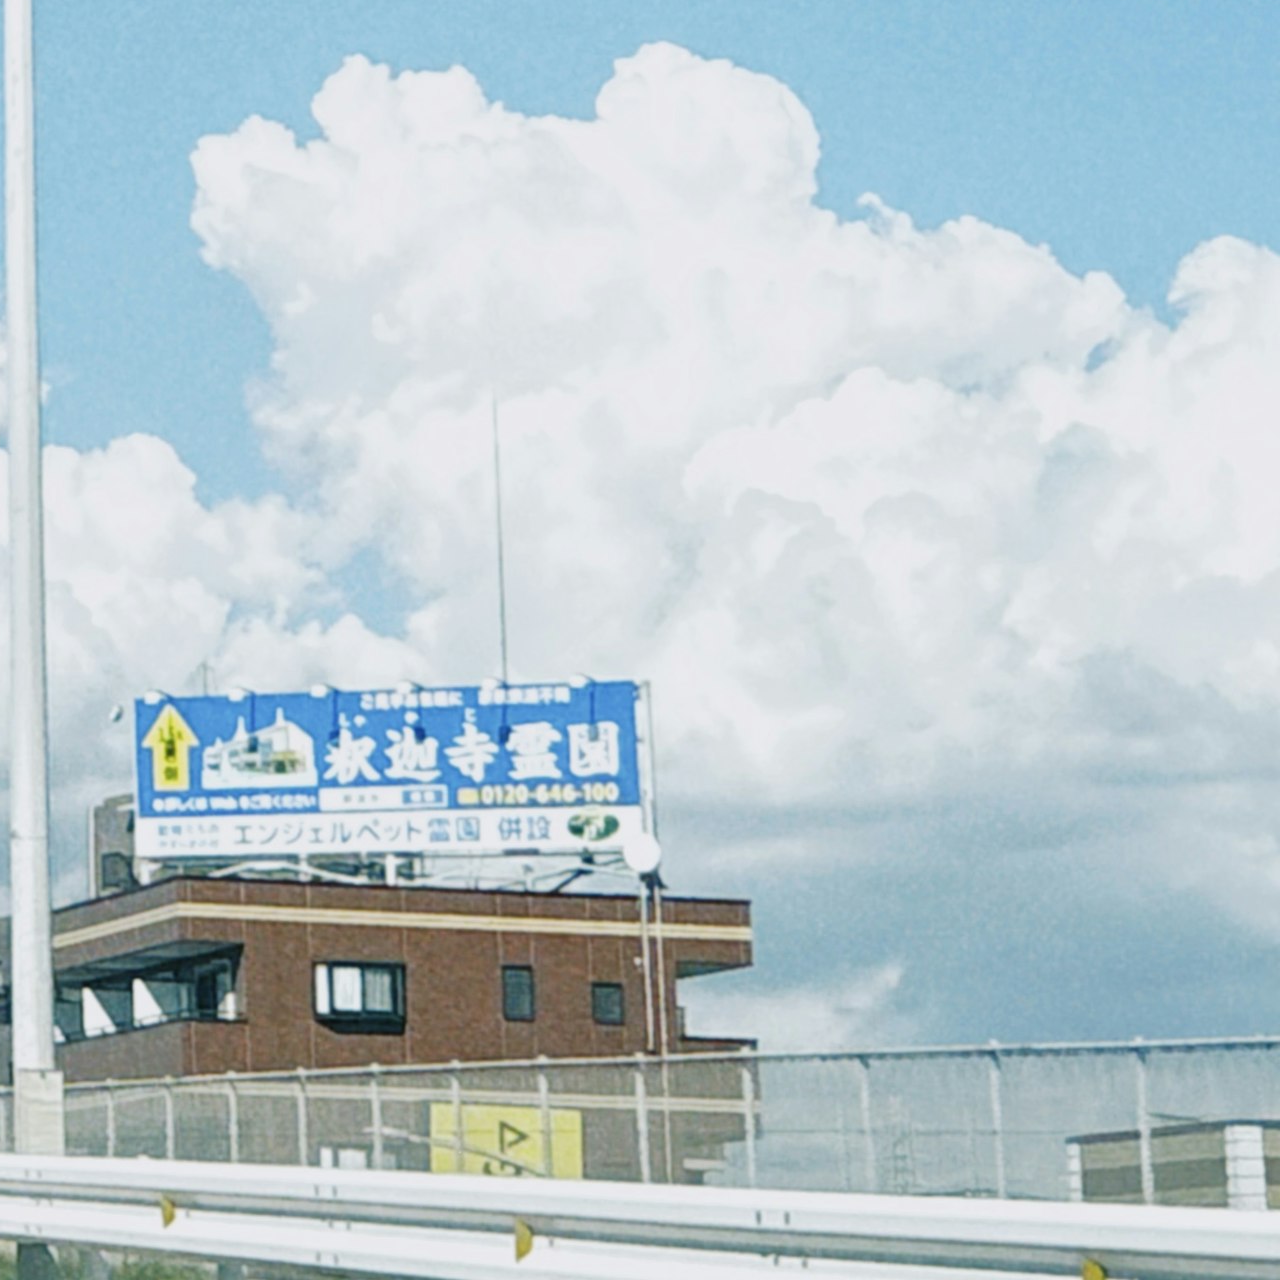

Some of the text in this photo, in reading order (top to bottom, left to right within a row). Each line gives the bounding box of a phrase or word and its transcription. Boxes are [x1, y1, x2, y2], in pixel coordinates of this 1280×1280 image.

[324, 721, 619, 784] 釈迦寺霊園
[480, 782, 620, 805] 0120-646-100
[234, 816, 482, 845] エンジェルペット霊園
